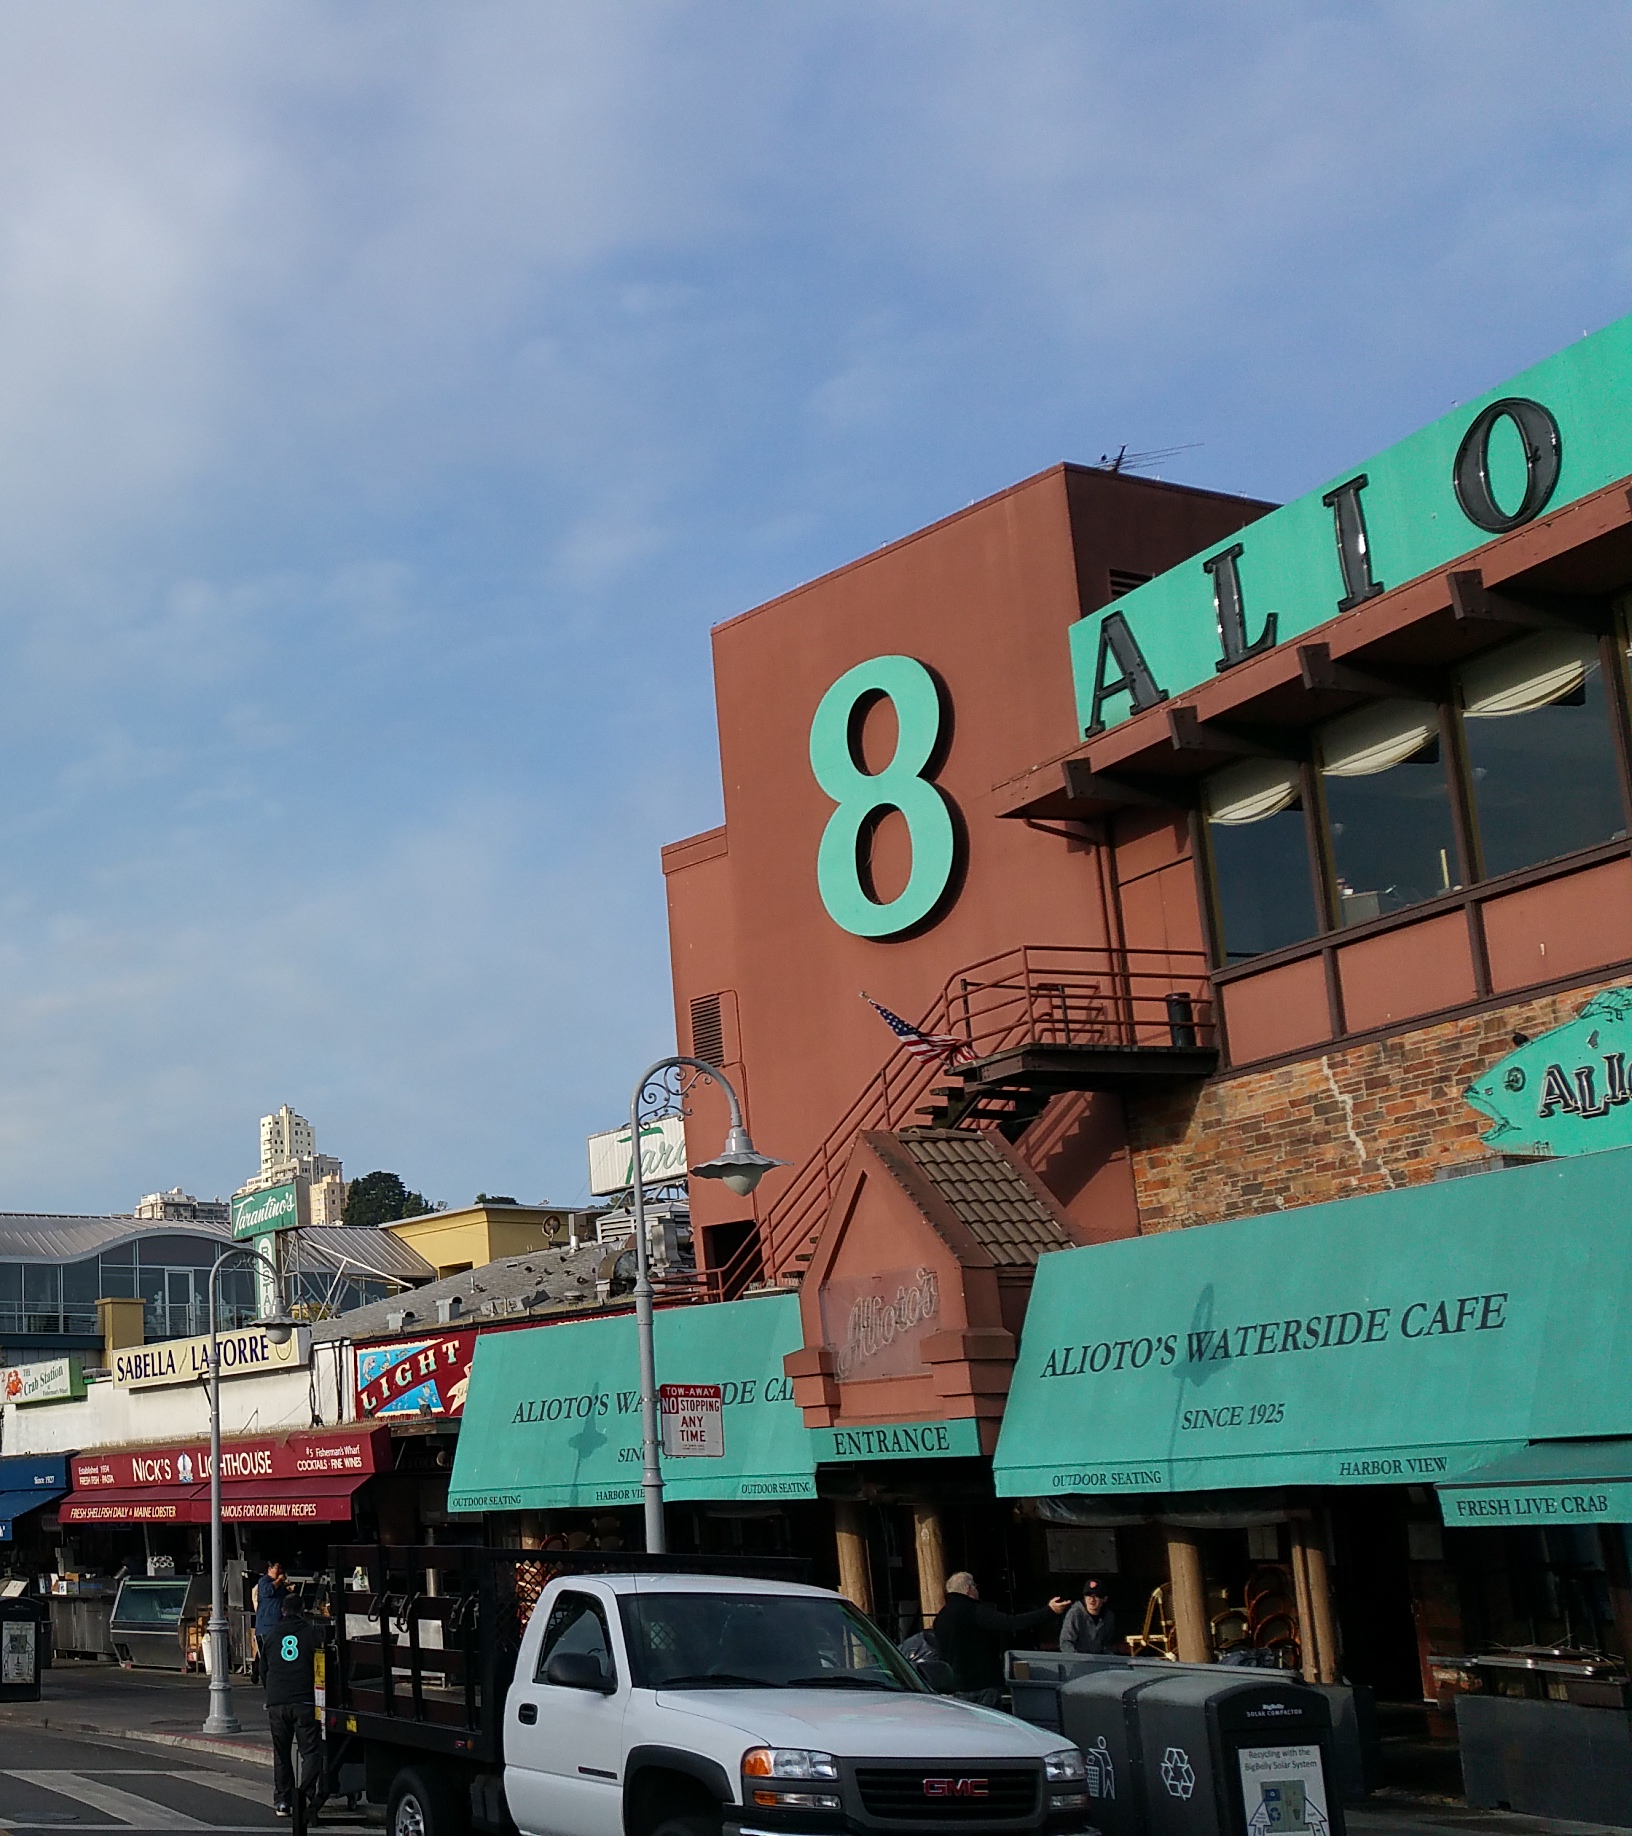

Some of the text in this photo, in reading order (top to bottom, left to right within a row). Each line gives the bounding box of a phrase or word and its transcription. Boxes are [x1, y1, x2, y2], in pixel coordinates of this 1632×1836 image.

[809, 654, 955, 937] 8
[1537, 1052, 1632, 1119] ALI
[233, 1191, 295, 1236] Tarantino's
[1039, 1291, 1509, 1380] ALIOTO'S WATERSIDE CAFE
[117, 1350, 176, 1382] SABELLA
[360, 1339, 462, 1411] LIGHT
[23, 1364, 64, 1396] Crab Station
[666, 1387, 715, 1396] TOW-AWAY
[511, 1392, 610, 1424] ALIOTO'S
[661, 1398, 720, 1414] NO STOPPING
[1181, 1402, 1285, 1431] SINCE 1925
[681, 1415, 704, 1428] ANY
[679, 1429, 707, 1443] TIME
[833, 1426, 950, 1456] ENTRANCE
[315, 1446, 345, 1457] Fisherman's
[344, 1444, 360, 1456] Wharf
[78, 1465, 99, 1475] Established
[132, 1457, 172, 1483] NICK'S
[297, 1456, 363, 1472] COCKTAILS FINE WINES
[1052, 1455, 1449, 1488] OUTDOOR SEATING HARBOR VIEW
[34, 1476, 45, 1485] Since
[79, 1474, 115, 1486] FRESH FISH PASTA
[452, 1481, 811, 1507] OUTDOOR SEATING HARBOR VIE OUTDOOR SEATING
[1456, 1492, 1609, 1518] FRESH LIVE CRAB
[70, 1507, 87, 1519] FRESH
[86, 1507, 113, 1519] SHELLFISH
[112, 1506, 129, 1518] DAILY
[133, 1506, 152, 1518] MAINE
[151, 1505, 177, 1518] LOBSTER
[243, 1505, 256, 1517] FOR
[255, 1504, 269, 1517] OUR
[269, 1504, 292, 1517] FAMILY
[291, 1503, 317, 1516] RECIPES
[280, 1634, 299, 1662] 8
[1246, 1708, 1303, 1718] SOLAR COMPACTOR
[1248, 1747, 1311, 1760] Recycling with the
[1244, 1760, 1318, 1773] BigBelly Solar System
[922, 1777, 990, 1797] GMC
